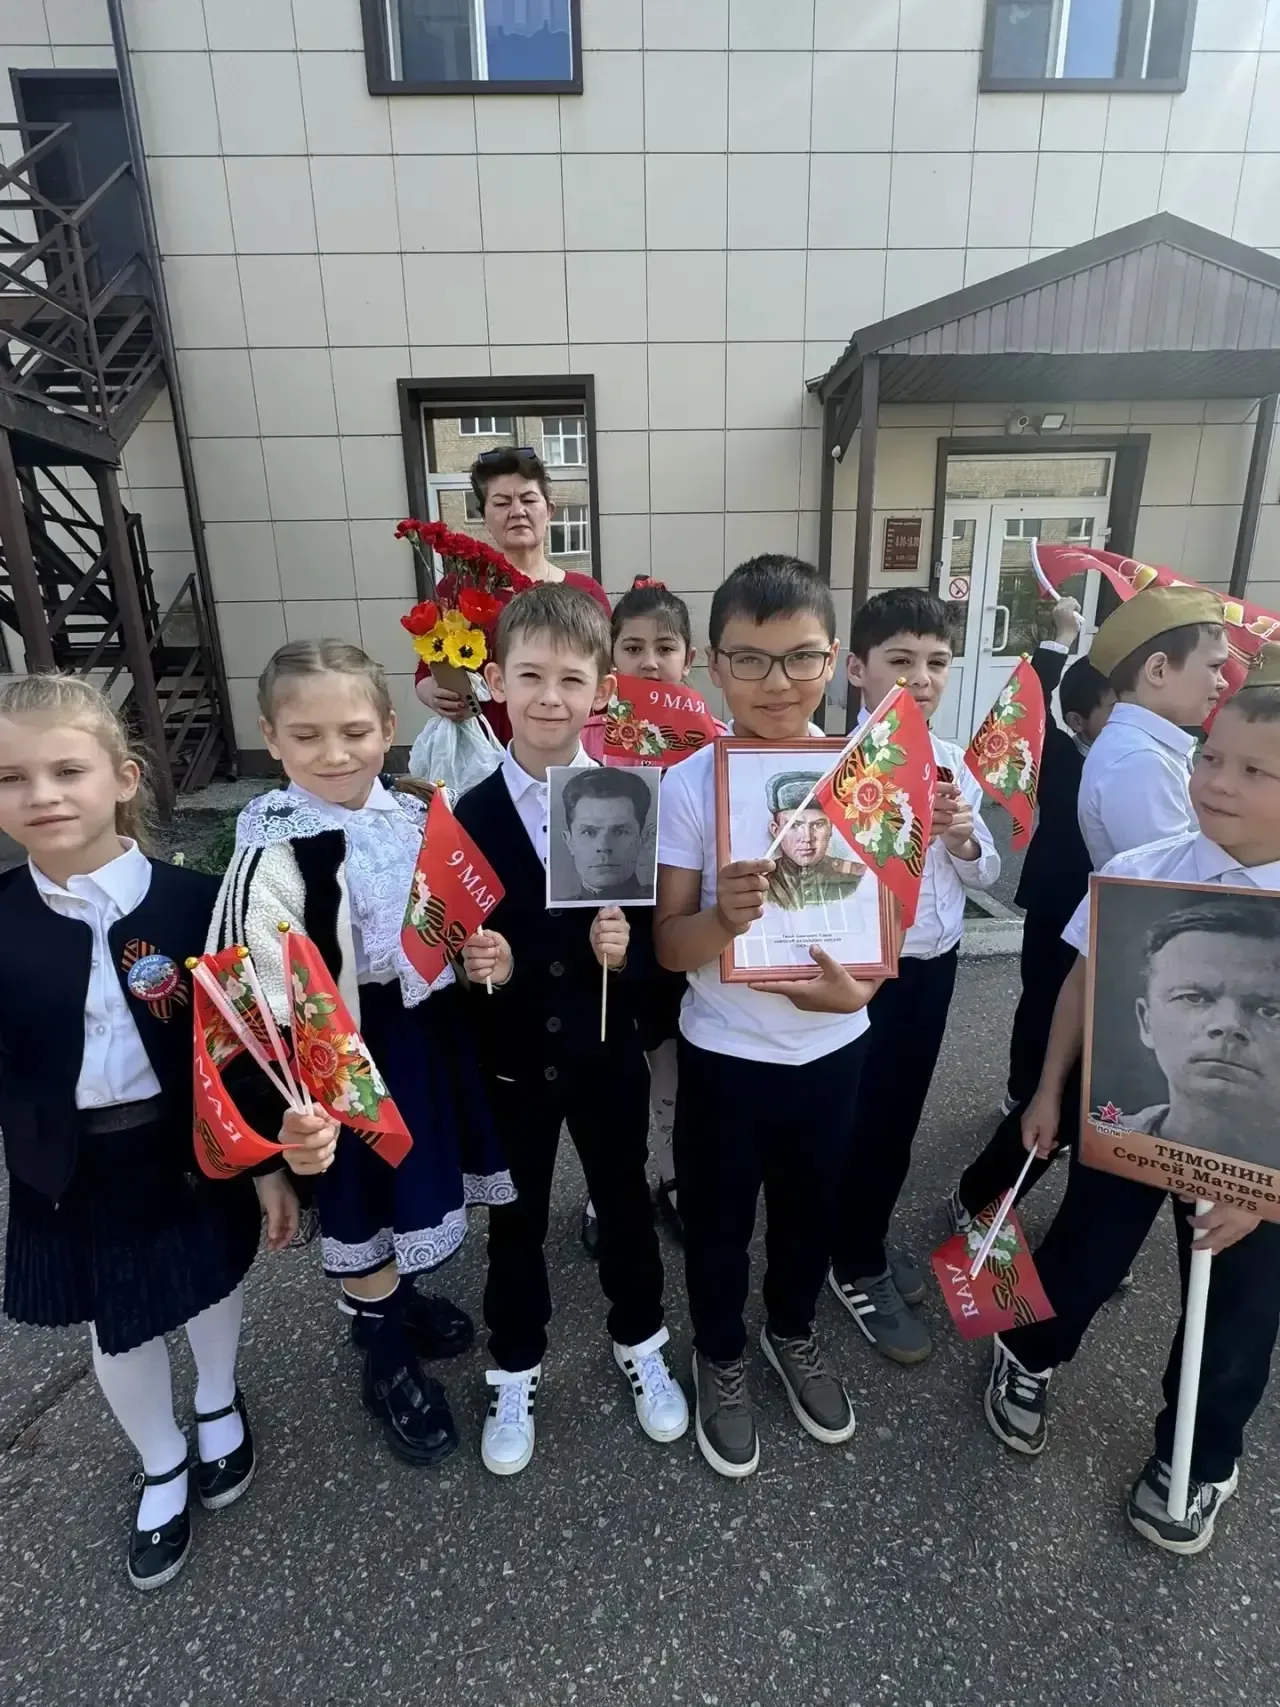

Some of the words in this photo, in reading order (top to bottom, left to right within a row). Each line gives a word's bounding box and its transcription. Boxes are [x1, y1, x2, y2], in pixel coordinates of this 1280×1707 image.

[649, 690, 660, 705] 9
[662, 693, 706, 715] МАЯ
[444, 850, 465, 866] 9
[456, 862, 497, 913] МАЯ
[1113, 1146, 1185, 1176] Сергей
[1154, 1144, 1275, 1188] ТИМОНИН
[1166, 1176, 1258, 1212] 1920-1975
